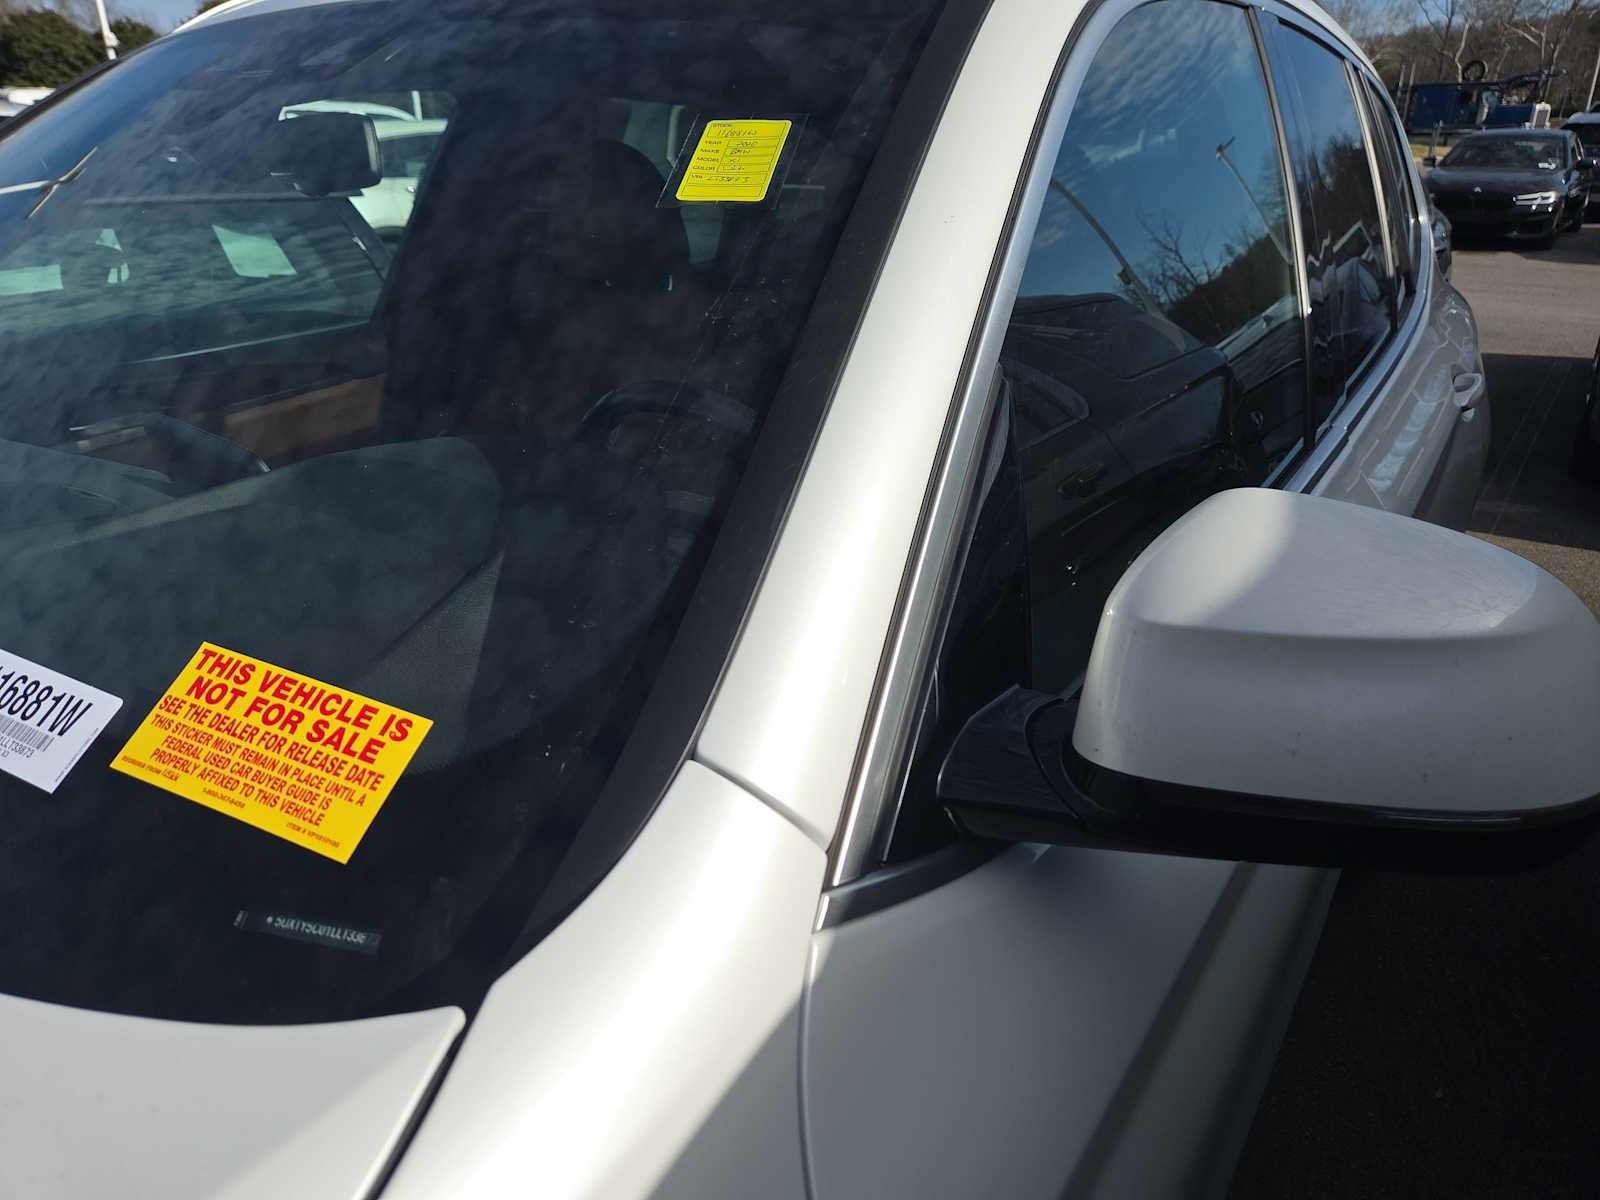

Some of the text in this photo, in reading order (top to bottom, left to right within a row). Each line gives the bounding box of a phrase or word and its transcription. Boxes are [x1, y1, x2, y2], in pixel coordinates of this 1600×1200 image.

[0, 665, 93, 737] 16881W
[185, 676, 386, 764] NOT FOR SALE
[196, 649, 413, 742] THIS VEHICLE IS
[151, 748, 200, 775] PROPERLY
[197, 767, 240, 791] AFFIXED
[240, 783, 255, 797] TO
[255, 789, 280, 808] THIS
[280, 799, 324, 826] VEHICLE
[152, 714, 367, 807] THIS STICKER MUST REMAIN IN PLACE UNTIL A
[159, 695, 384, 791] SEE THE DEALER FOR RELEASE DATE
[162, 735, 332, 810] FEDERAL USED CAR BUYER GUIDE IS
